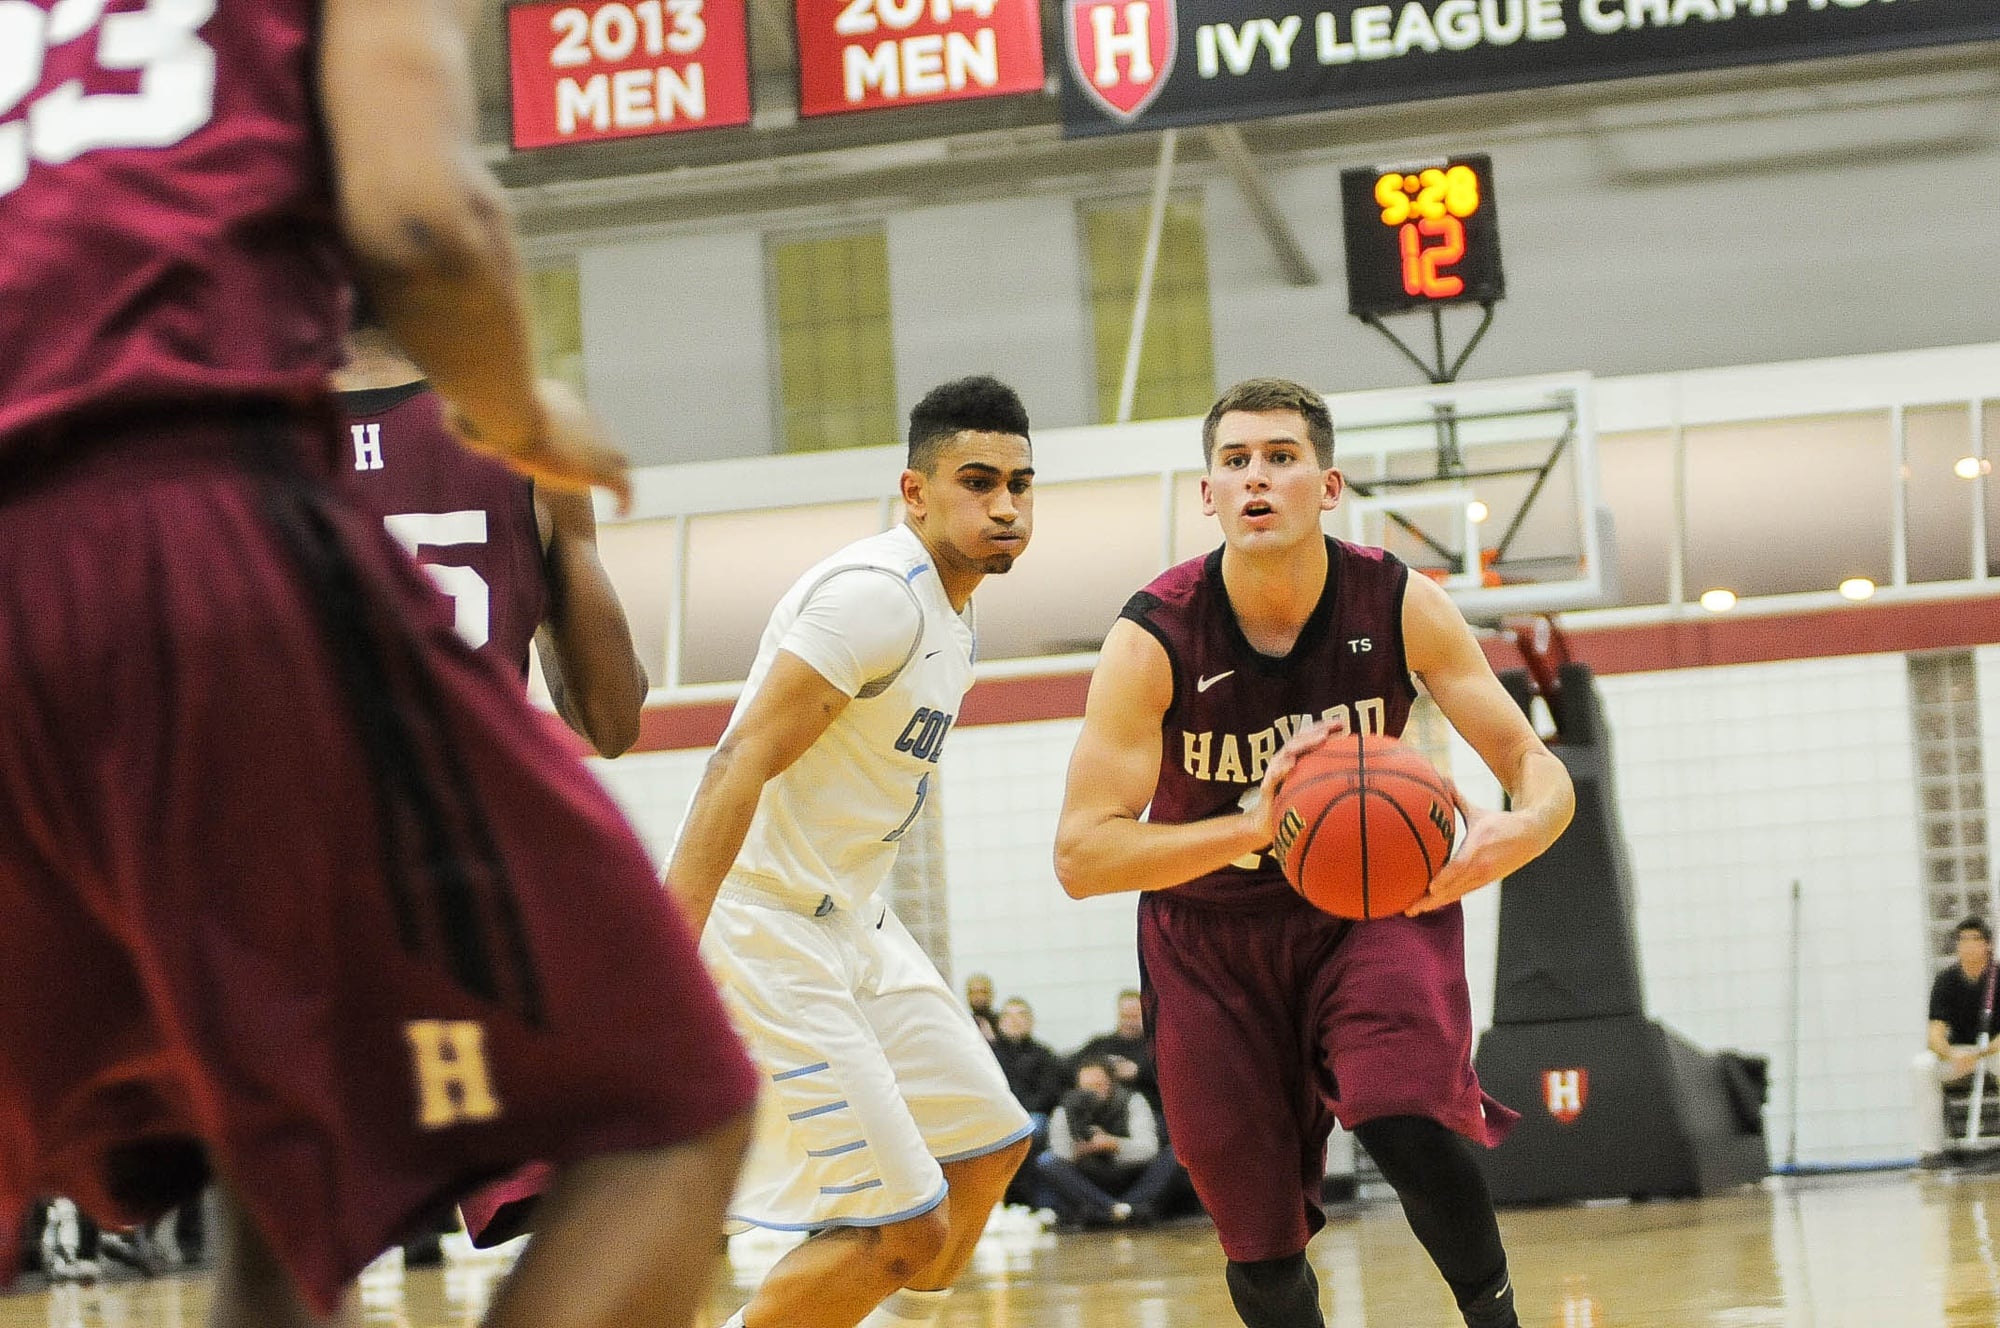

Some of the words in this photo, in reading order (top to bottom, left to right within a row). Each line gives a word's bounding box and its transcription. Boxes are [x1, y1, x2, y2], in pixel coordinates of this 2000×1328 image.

[550, 0, 707, 67] 2013
[842, 27, 999, 103] MEN
[1091, 0, 1155, 87] H
[1197, 15, 1301, 79] IVY
[1315, 0, 1568, 66] LEAGUE
[0, 0, 217, 197] 3
[556, 61, 707, 135] MEN
[1399, 215, 1466, 298] 12
[351, 423, 384, 471] H
[1347, 638, 1372, 653] TS
[403, 1018, 501, 1130] H
[1548, 1069, 1583, 1114] H
